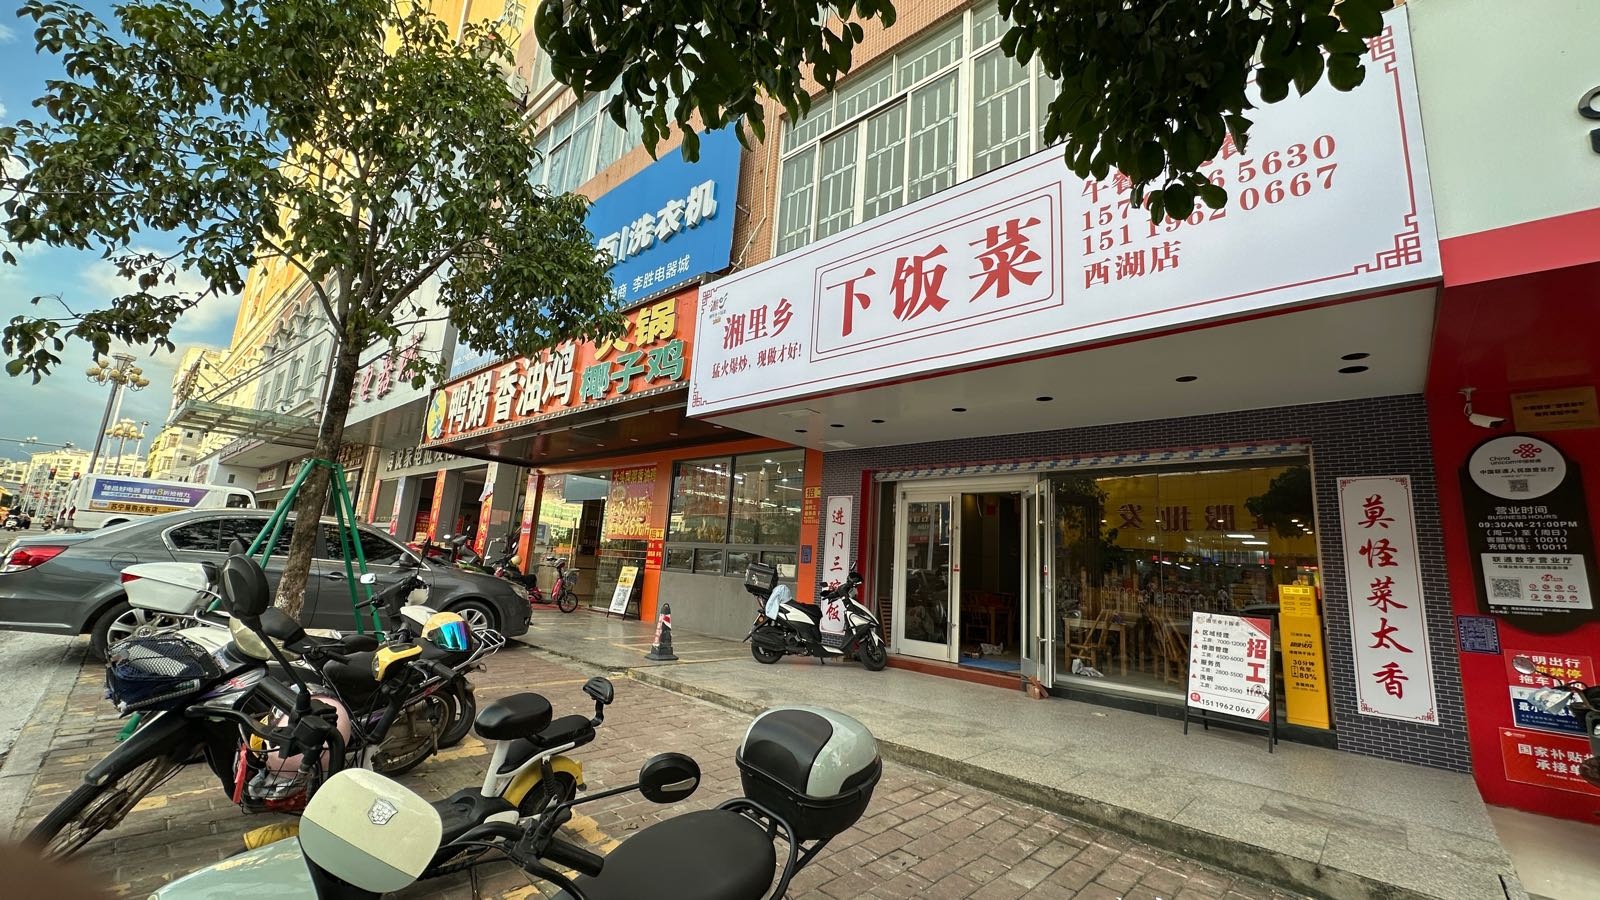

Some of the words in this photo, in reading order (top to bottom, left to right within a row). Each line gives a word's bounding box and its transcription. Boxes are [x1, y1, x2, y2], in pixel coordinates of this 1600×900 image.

[1082, 198, 1131, 232] 157
[1238, 135, 1336, 184] 5630
[1082, 225, 1133, 256] 151
[1239, 163, 1338, 211] 0667
[632, 254, 690, 293] 李胜电器城
[825, 216, 1043, 338] 下饭菜
[1083, 240, 1181, 289] 西湖店
[723, 297, 794, 350] 湘里乡
[447, 340, 579, 434] 鸭粥香油鸡
[579, 339, 685, 402] 椰子鸡
[1478, 521, 1578, 529] 09:30AM-21:00PM
[1495, 506, 1548, 515] 营业时间
[1492, 556, 1572, 565] 联通数字营业厅
[1358, 493, 1413, 700] 莫怪菜太香
[1202, 629, 1230, 639] 区域经理
[1200, 659, 1221, 668] 服务员
[1246, 638, 1267, 684] 招工
[1299, 673, 1317, 681] 80%
[1201, 699, 1214, 707] 151
[1216, 700, 1234, 711] 1962
[1235, 705, 1256, 715] 0667
